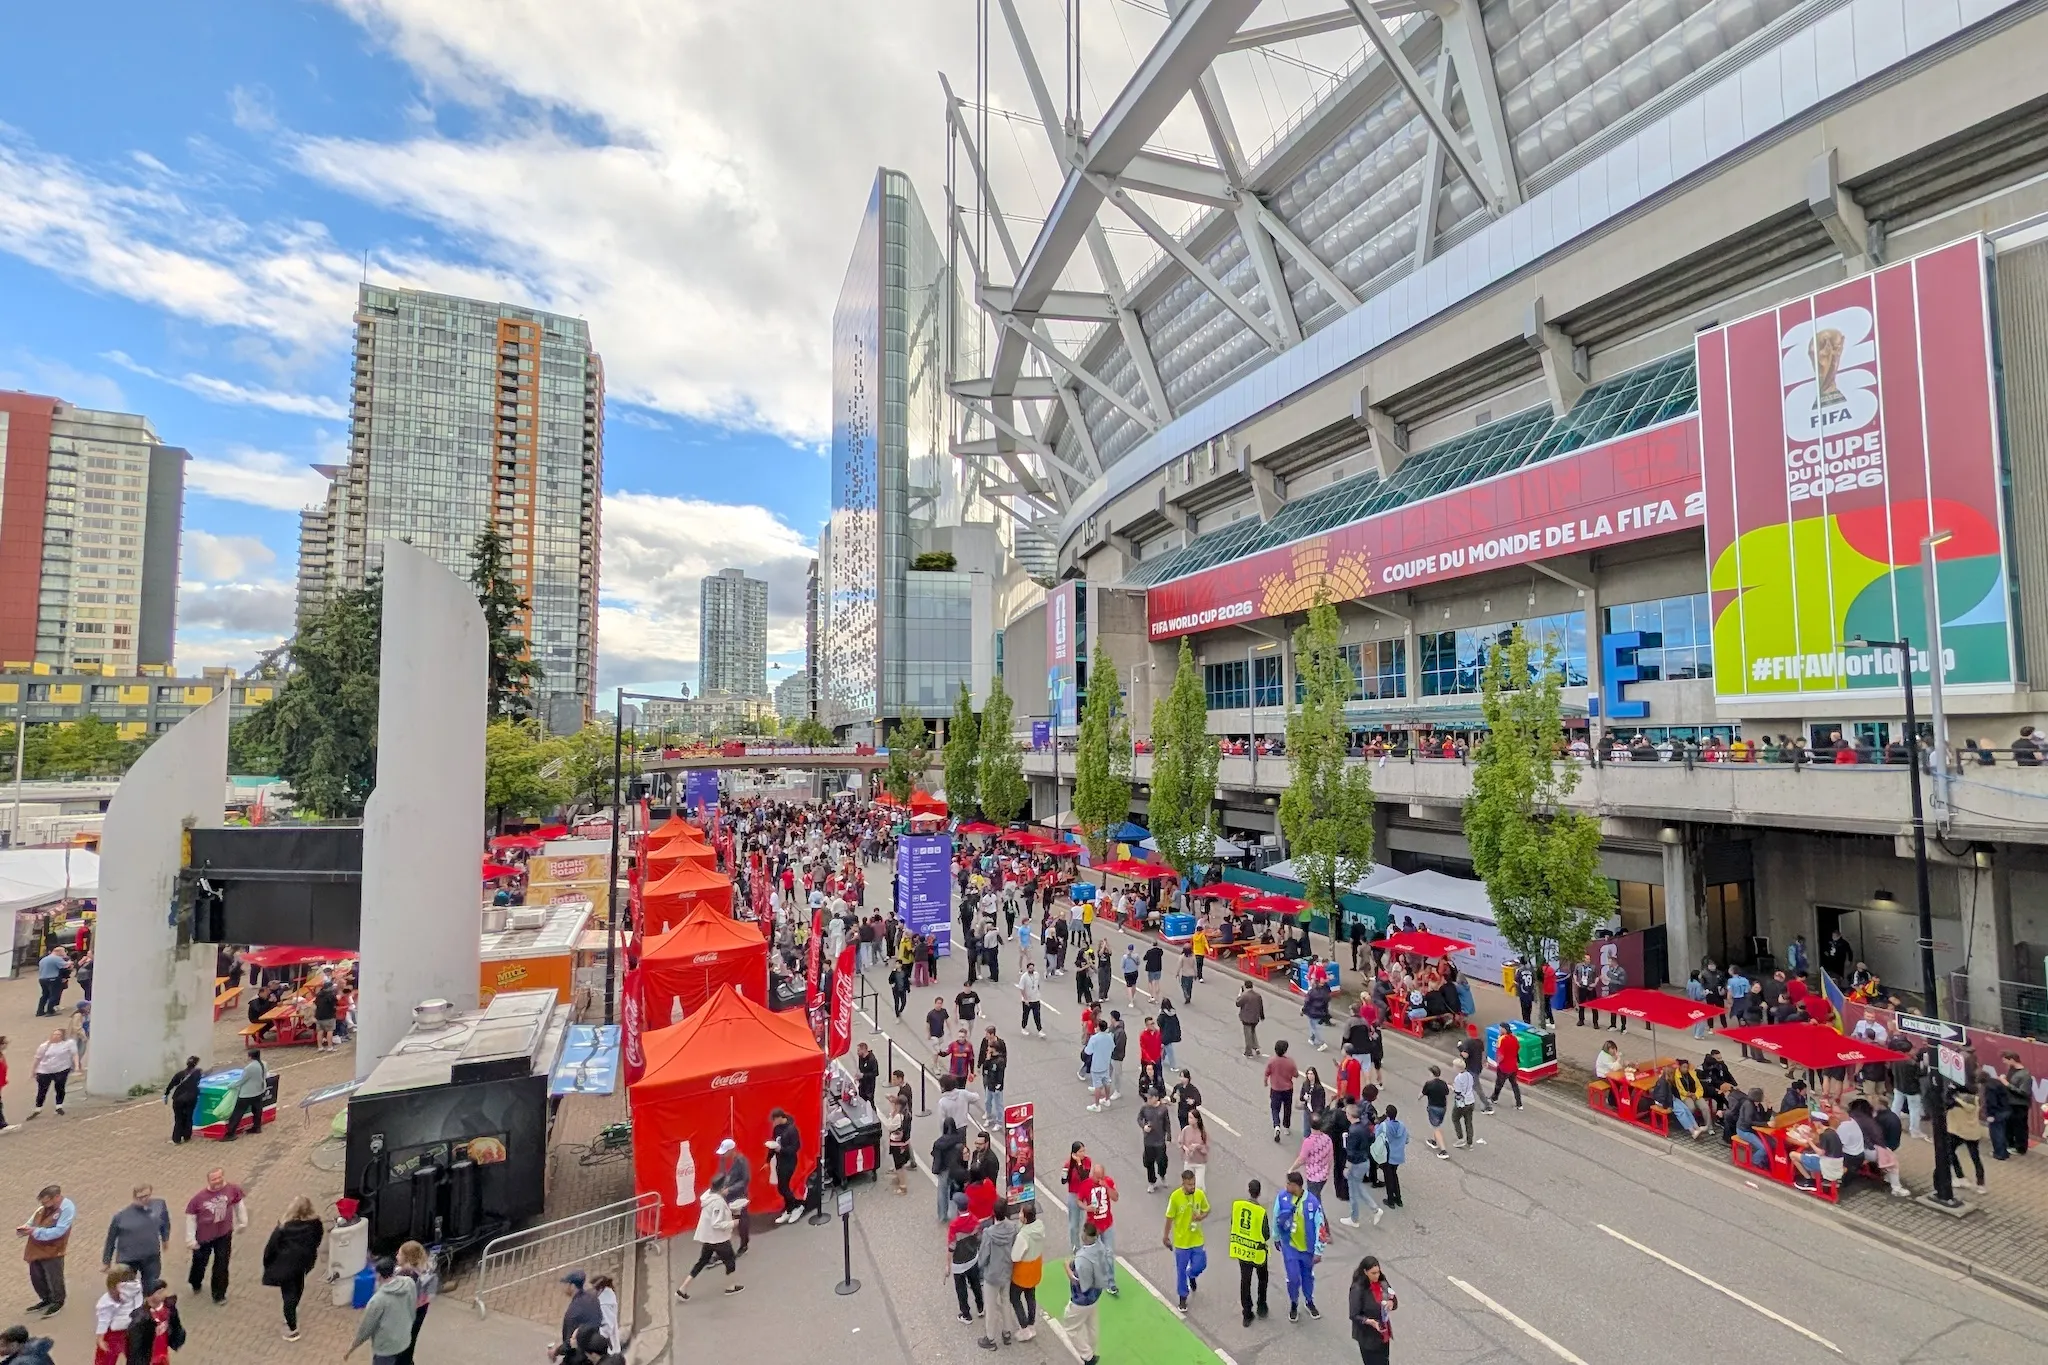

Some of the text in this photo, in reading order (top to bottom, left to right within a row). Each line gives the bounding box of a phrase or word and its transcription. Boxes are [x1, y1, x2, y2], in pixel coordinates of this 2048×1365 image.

[1810, 408, 1852, 428] FIFA
[1788, 431, 1880, 467] COUPE
[1789, 452, 1882, 482] DU MONDE
[1789, 468, 1883, 502] 2026
[1382, 555, 1437, 583] COUPE
[1439, 548, 1465, 572] DU
[1468, 529, 1542, 564] MONDE
[1545, 521, 1576, 548] DE
[1580, 514, 1613, 540] LA
[1617, 499, 1678, 532] FIFA
[1151, 600, 1253, 635] FIFA WORLD CUP 2026
[1602, 631, 1649, 718] E
[550, 866, 585, 876] Potato
[693, 953, 718, 963] Coca-Cola
[834, 970, 854, 1039] Coca-Cola
[1903, 1020, 1940, 1032] ONE WAY
[711, 1070, 750, 1089] Coca-Cola
[1230, 1234, 1260, 1250] SECURITY
[1233, 1246, 1256, 1258] 18725
